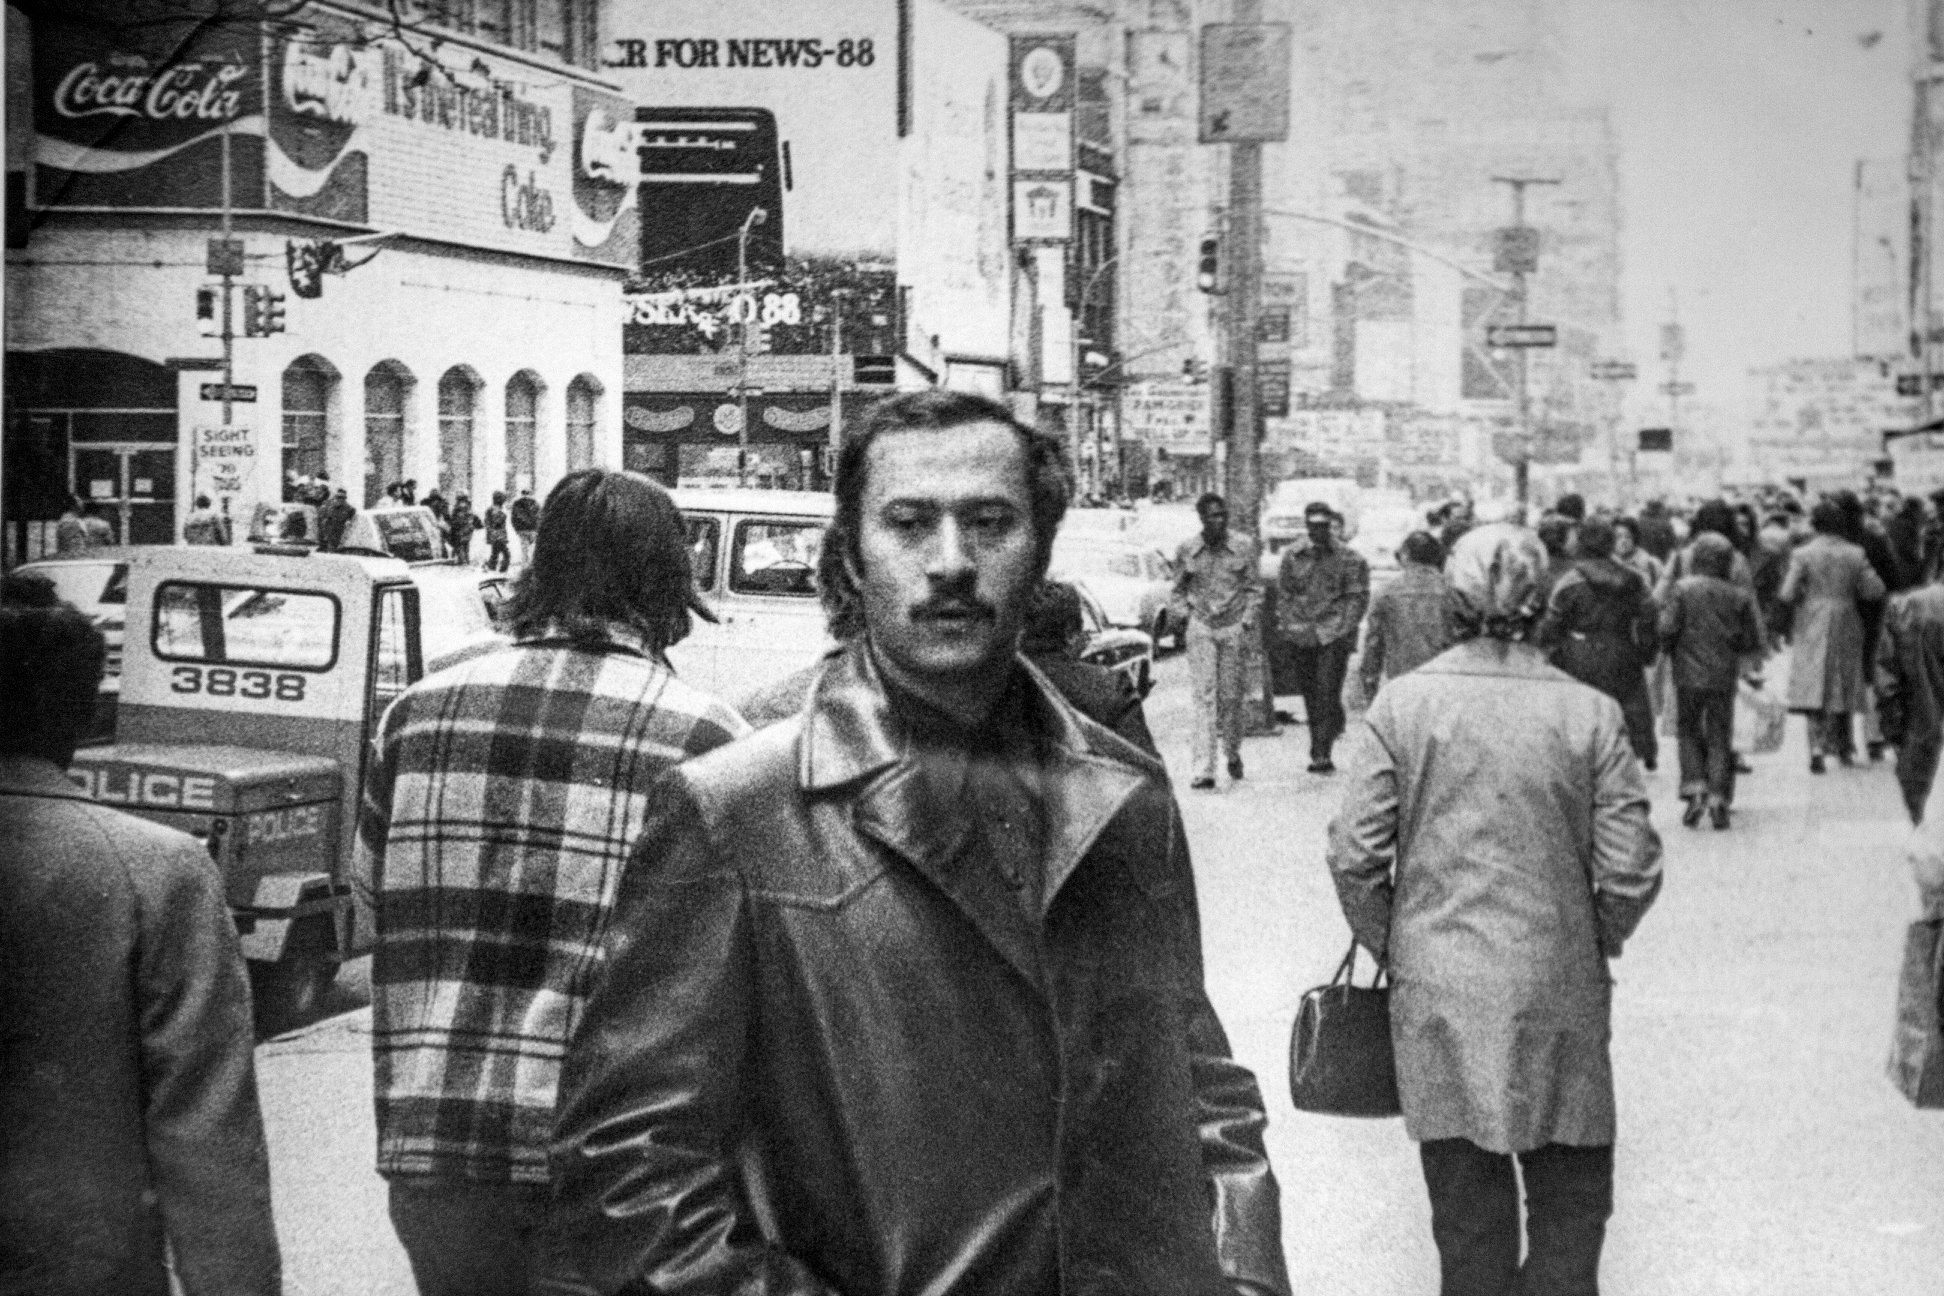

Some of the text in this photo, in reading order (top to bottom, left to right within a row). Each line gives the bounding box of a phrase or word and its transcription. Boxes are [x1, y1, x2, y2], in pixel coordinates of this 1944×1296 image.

[654, 38, 720, 68] FOR
[726, 38, 876, 68] NEWS-88
[762, 293, 801, 325] 88
[200, 444, 255, 458] SEEING
[204, 429, 250, 442] SIGHT
[171, 666, 307, 701] 3838
[249, 806, 319, 843] POLICE
